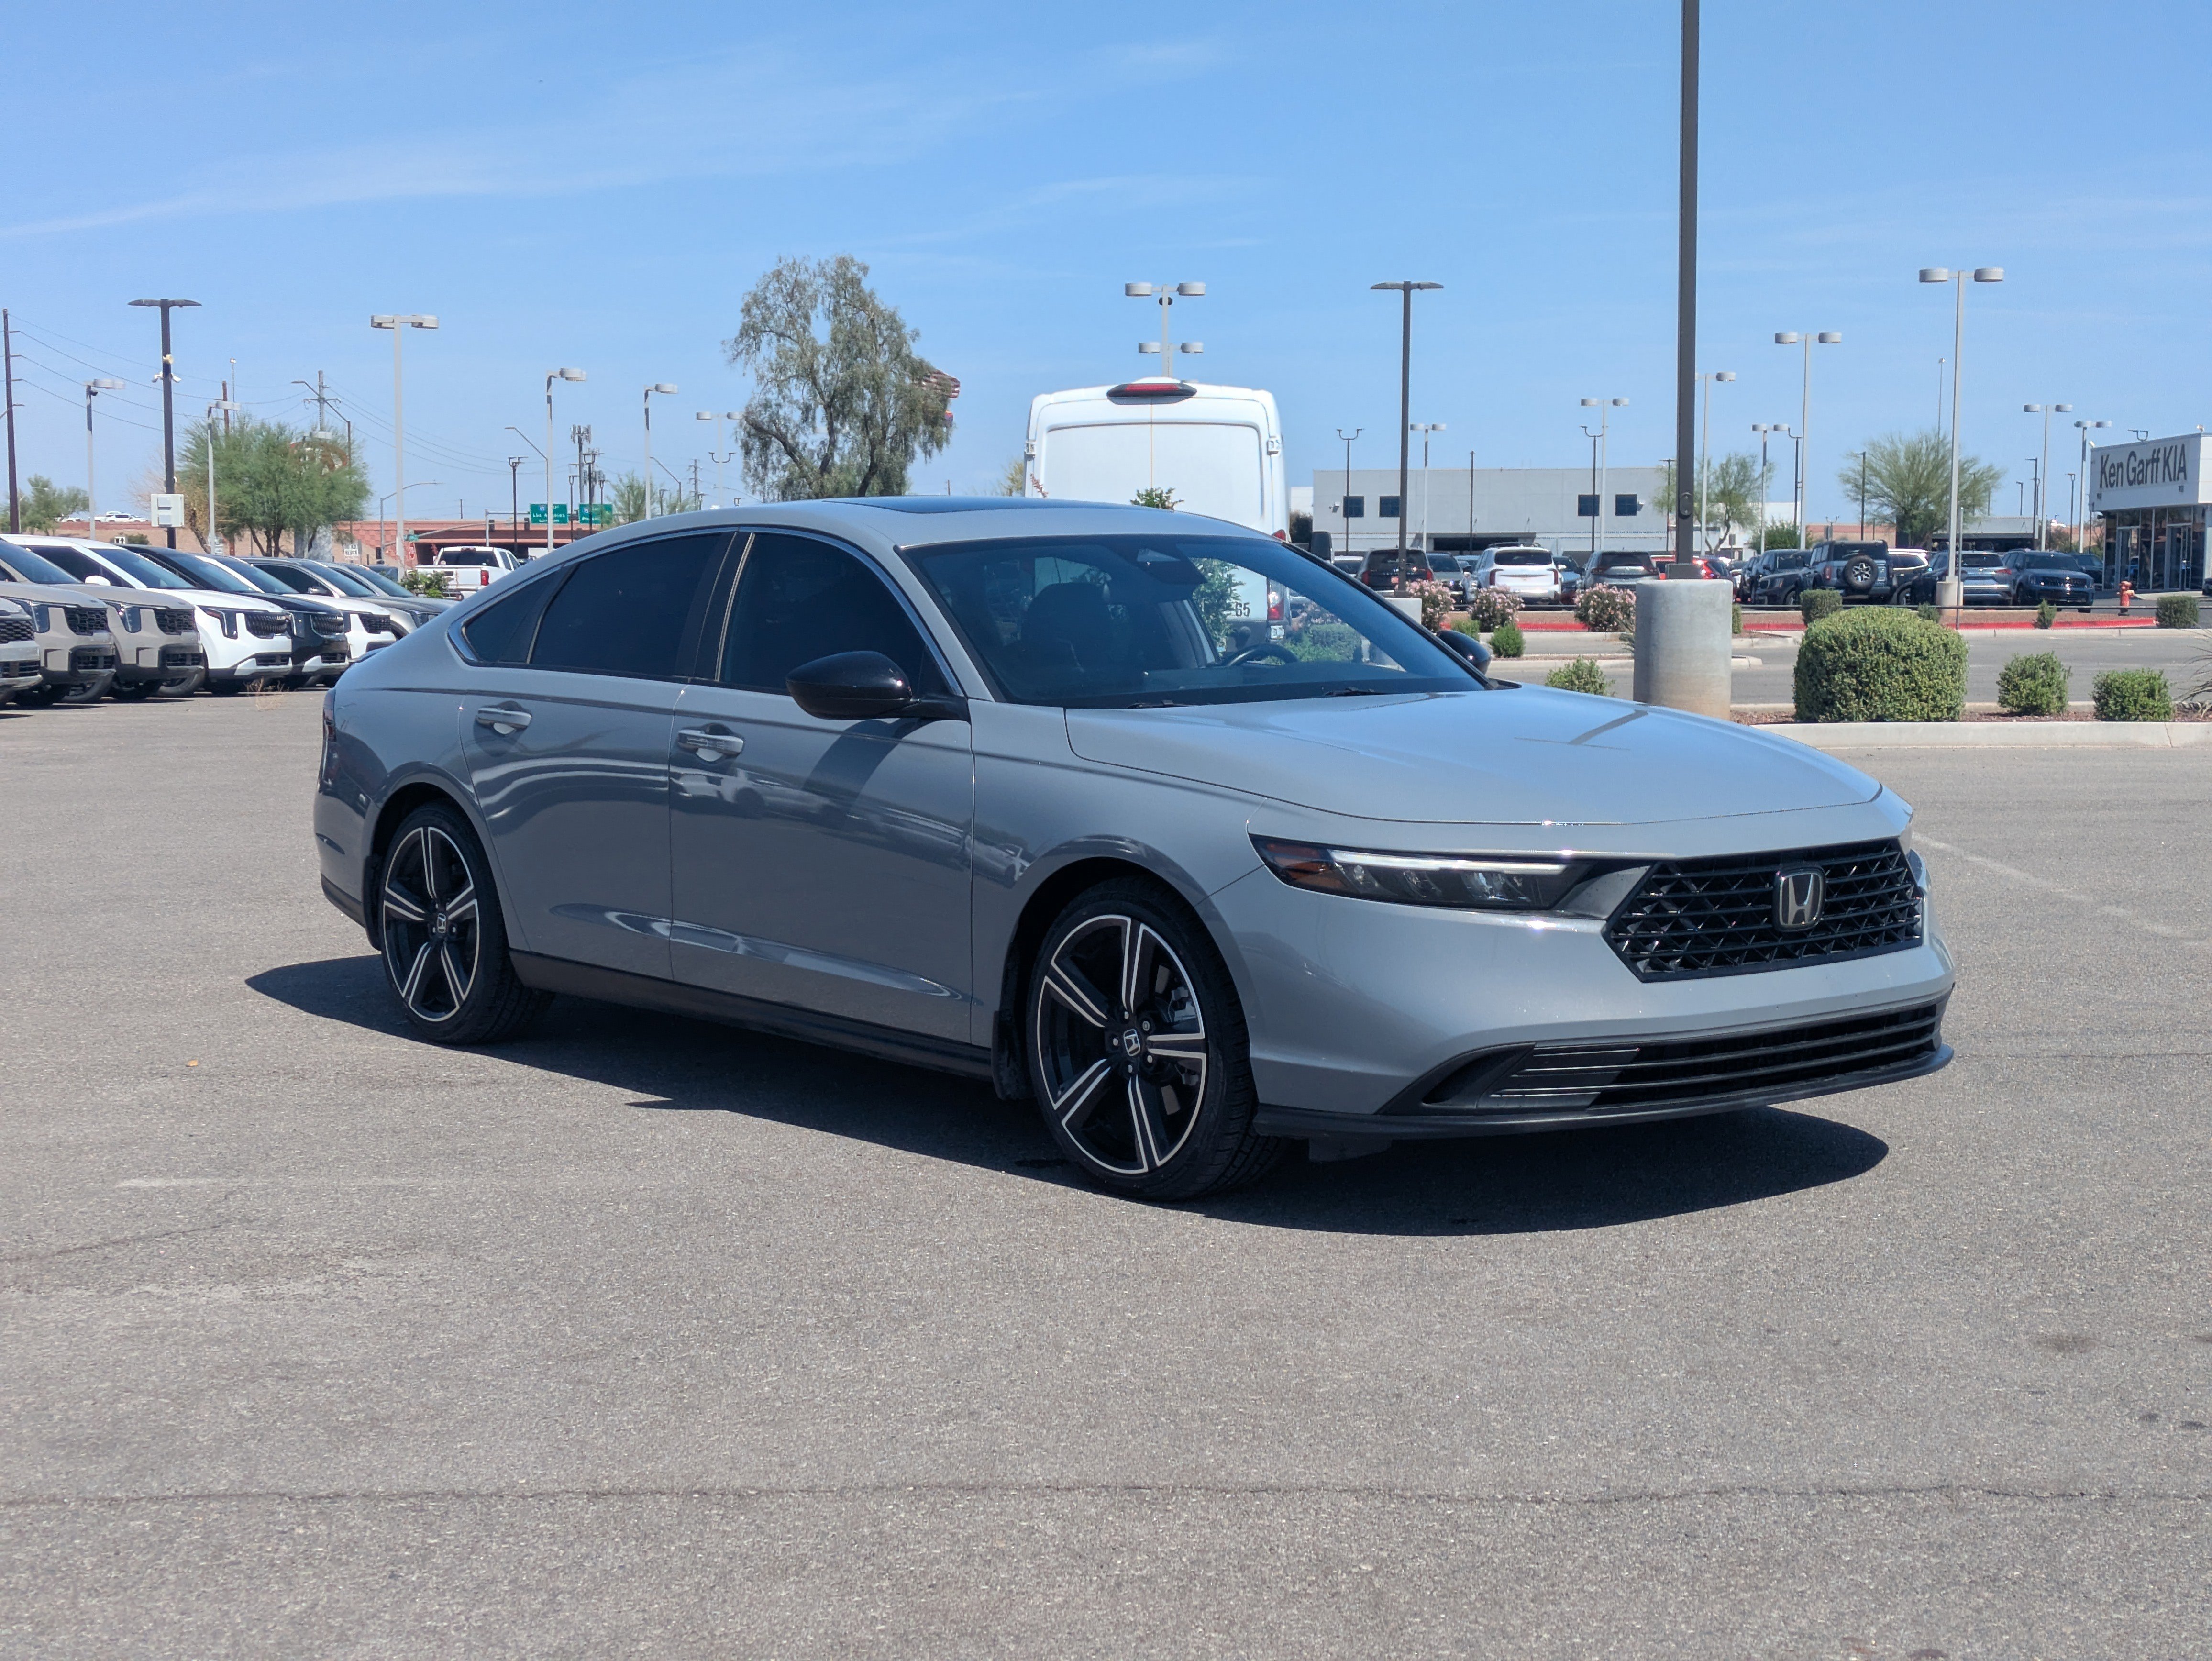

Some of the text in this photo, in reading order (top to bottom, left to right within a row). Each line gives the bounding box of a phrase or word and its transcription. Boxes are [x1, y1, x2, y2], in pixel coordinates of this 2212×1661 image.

[2100, 443, 2187, 488] Ken Garff KIA
[1235, 602, 1250, 617] 65
